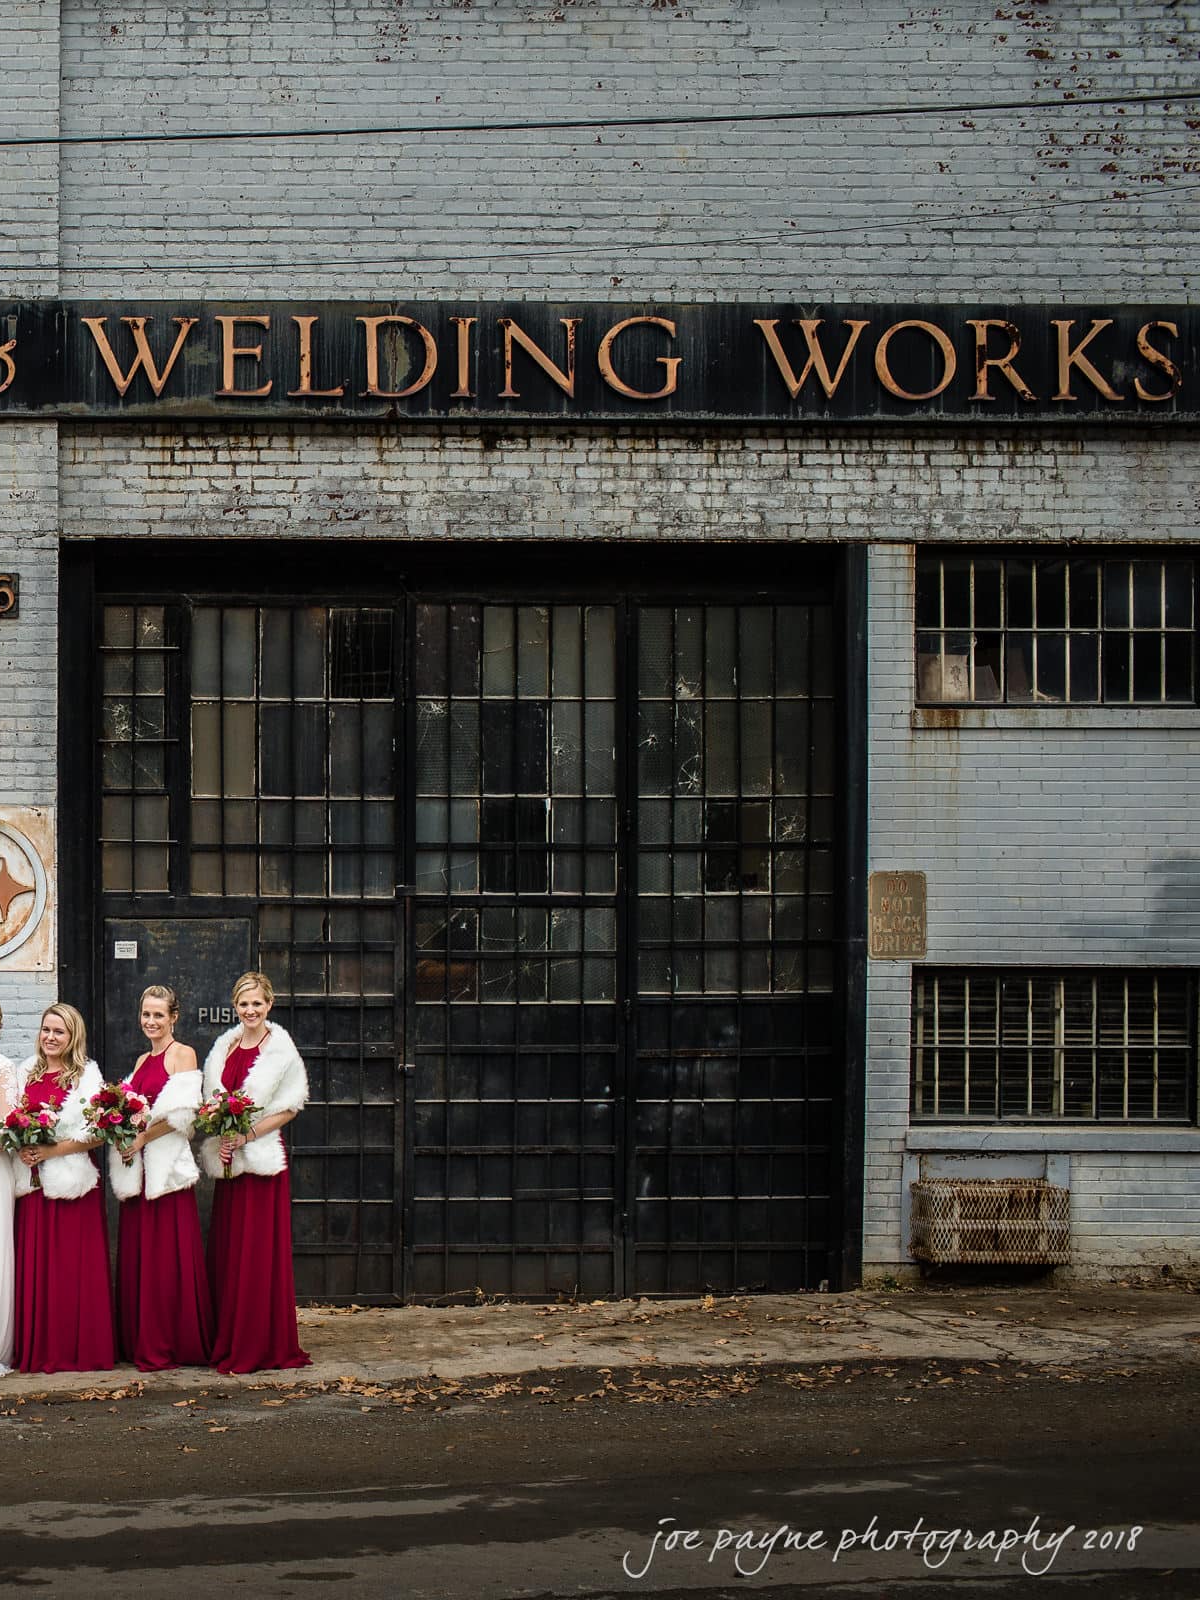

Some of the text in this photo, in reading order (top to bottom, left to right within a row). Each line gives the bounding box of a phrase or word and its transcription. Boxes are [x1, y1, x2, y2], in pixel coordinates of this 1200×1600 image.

[80, 315, 682, 400] WELDING
[752, 319, 1182, 401] WORKS
[886, 879, 908, 895] DO
[881, 896, 913, 913] NOT
[873, 916, 921, 932] BLOCK
[873, 934, 921, 952] DRIVE
